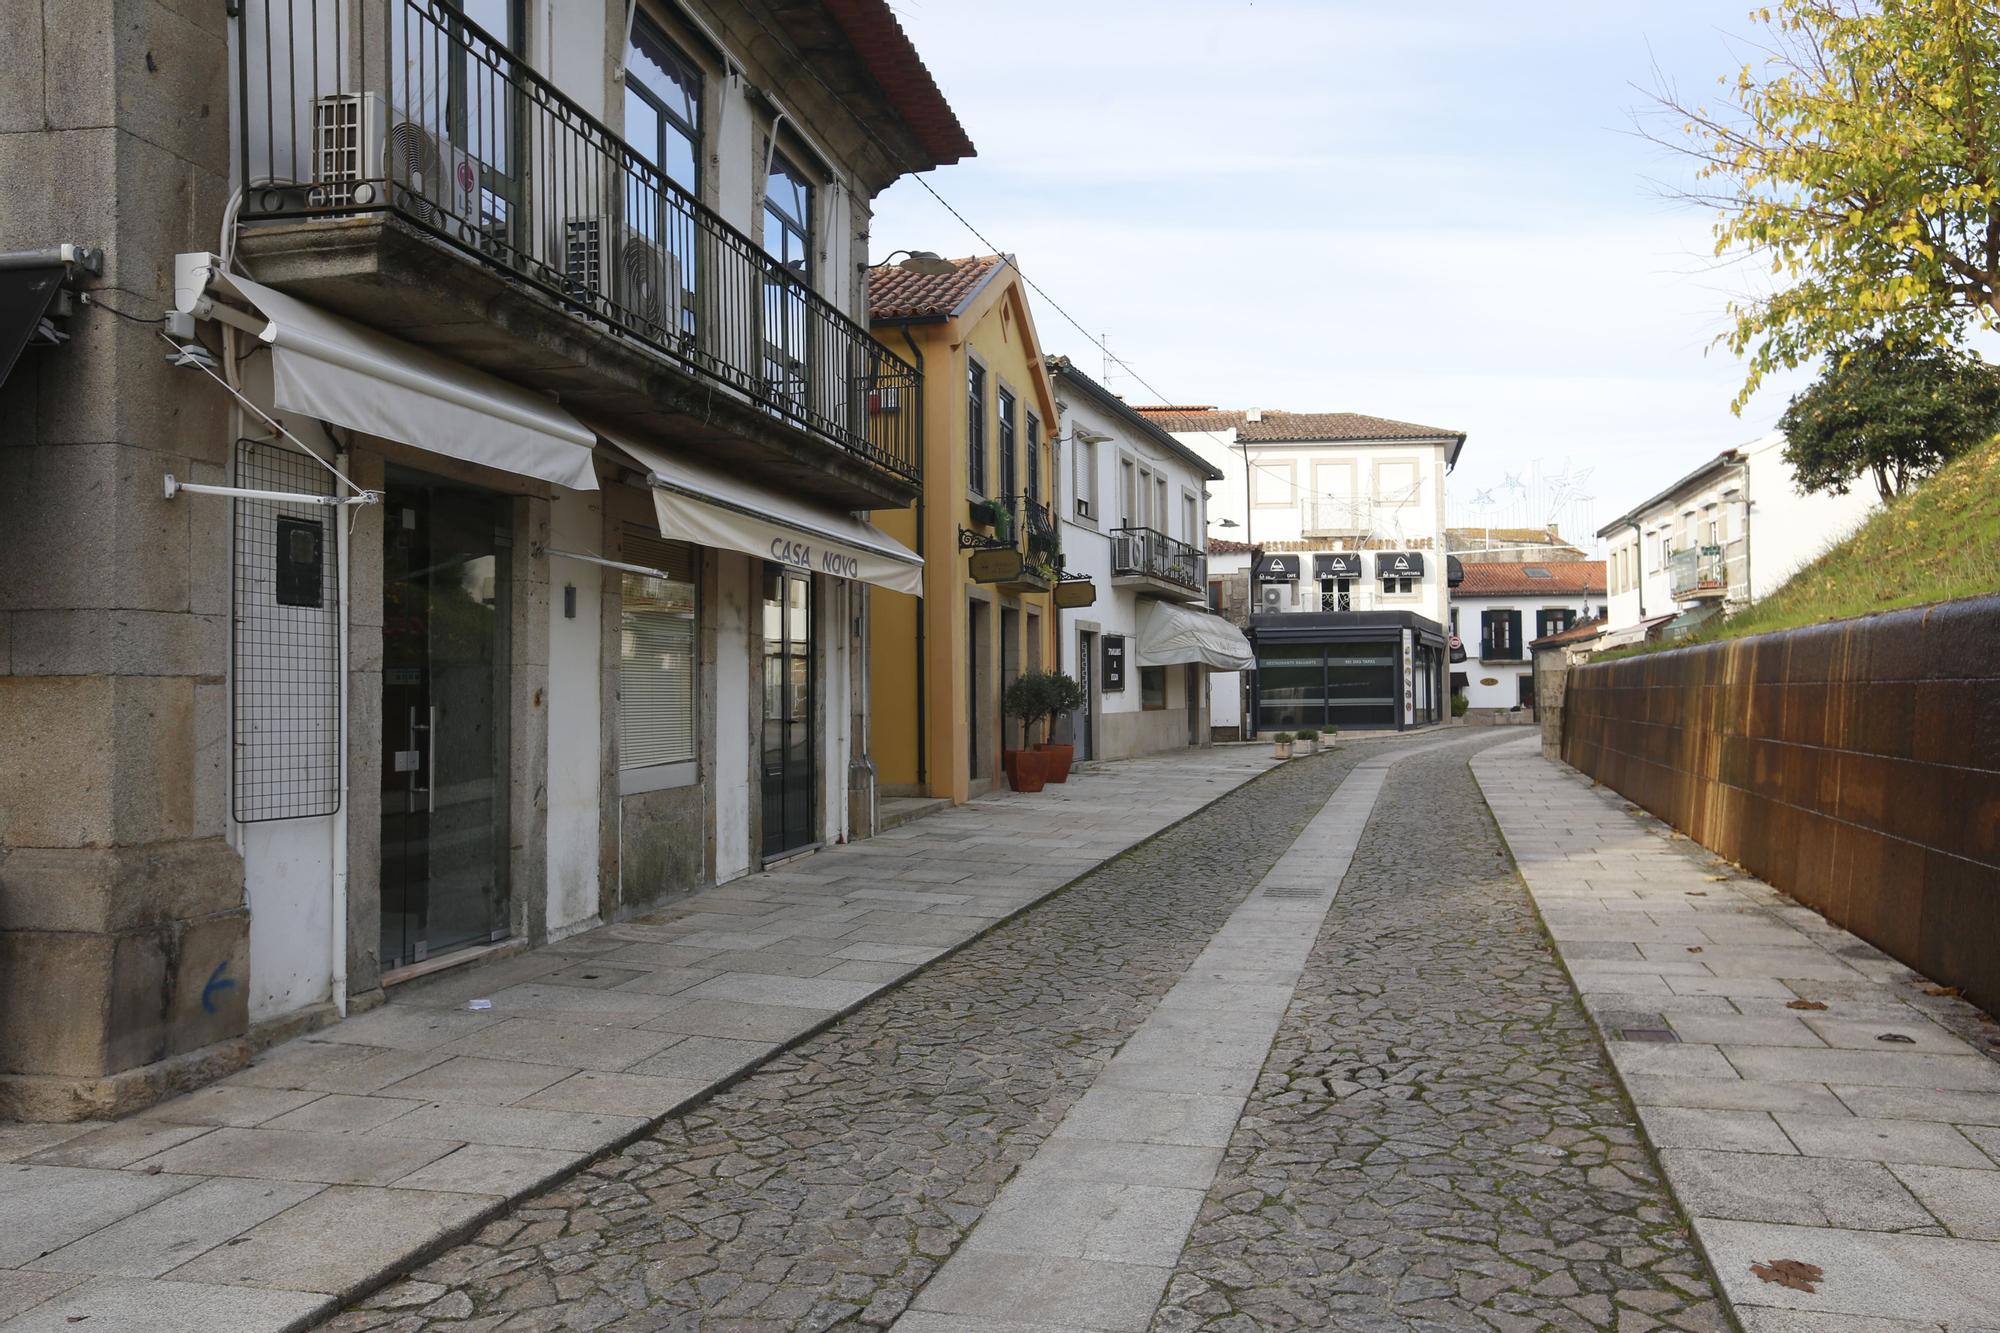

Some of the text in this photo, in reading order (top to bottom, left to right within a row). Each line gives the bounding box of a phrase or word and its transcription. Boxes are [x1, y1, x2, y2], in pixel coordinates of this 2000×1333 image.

[459, 194, 472, 215] LG
[771, 538, 857, 578] CASA NOVO
